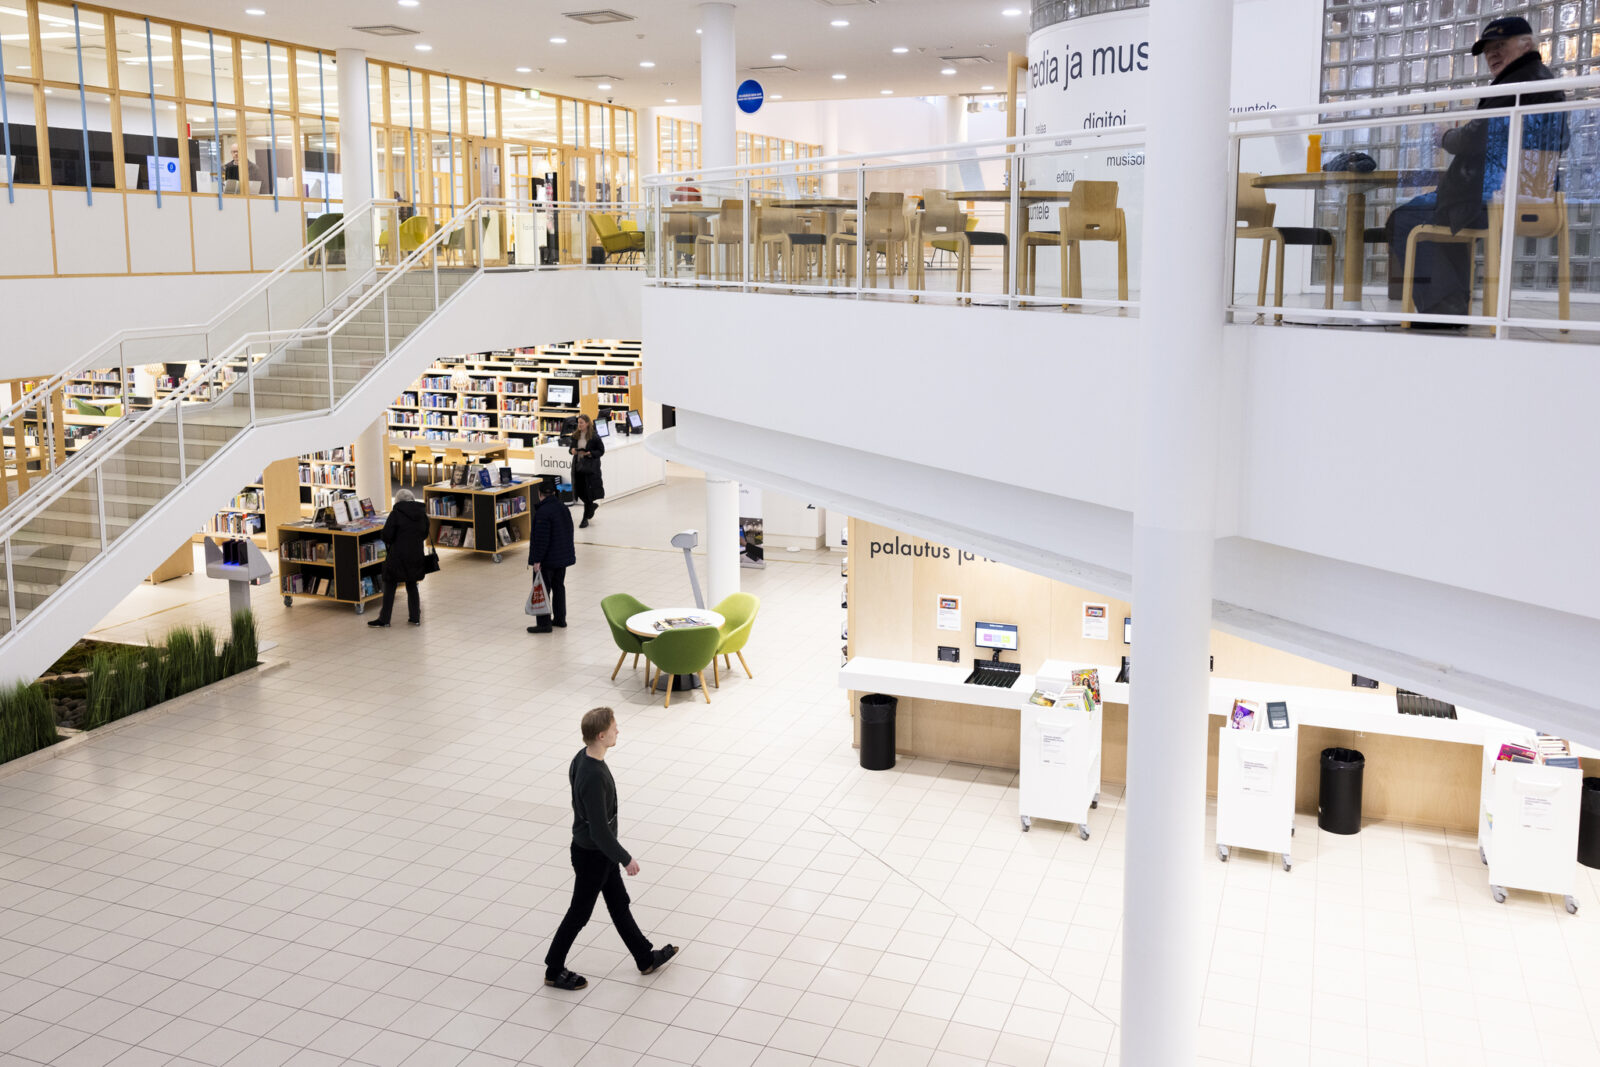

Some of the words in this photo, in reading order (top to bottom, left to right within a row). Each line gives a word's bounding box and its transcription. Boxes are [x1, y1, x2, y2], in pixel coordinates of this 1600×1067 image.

[1063, 44, 1083, 91] ja
[1056, 170, 1075, 183] editoi
[870, 535, 951, 560] palautus
